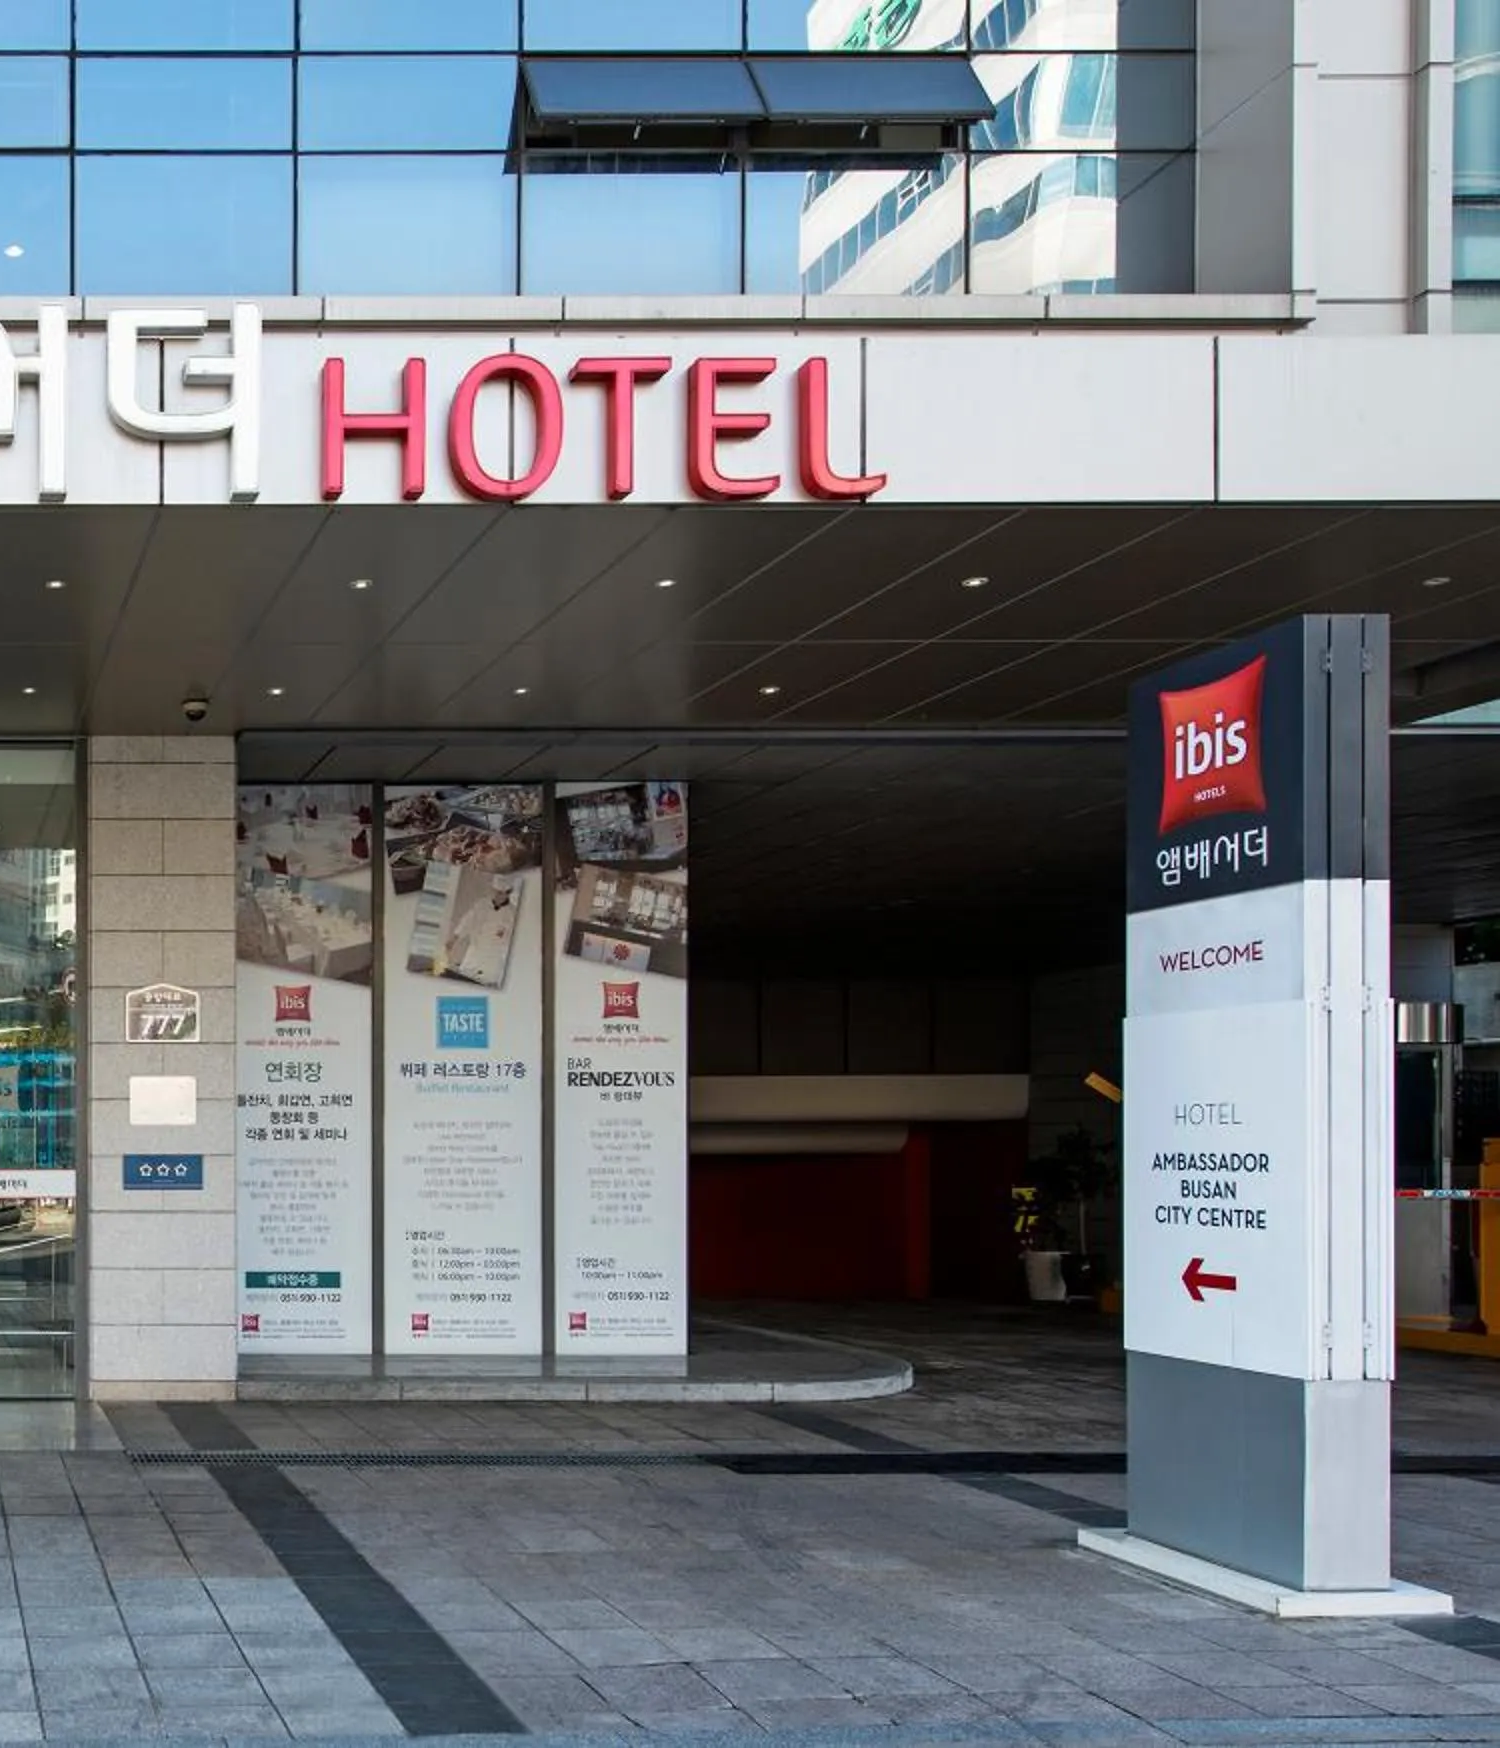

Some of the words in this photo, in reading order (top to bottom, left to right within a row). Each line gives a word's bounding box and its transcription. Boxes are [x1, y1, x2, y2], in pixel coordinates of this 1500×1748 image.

[321, 352, 887, 502] HOTEL
[1175, 711, 1247, 780] ibis
[1156, 826, 1268, 886] 앰배서더
[1160, 941, 1263, 973] WELCOME
[280, 995, 306, 1009] ibis
[608, 992, 635, 1007] ibis
[141, 1015, 186, 1035] 777
[443, 1013, 484, 1032] TASTE
[265, 1062, 322, 1083] 연회장
[433, 1062, 488, 1078] 레스토랑
[496, 1061, 527, 1079] 17층
[567, 1057, 592, 1070] BAR
[567, 1071, 676, 1087] RENDEZVOUS
[1174, 1103, 1243, 1126] HOTEL
[313, 1128, 348, 1141] 세미나
[1151, 1152, 1270, 1173] AMBASSADOR
[1181, 1179, 1237, 1201] BUSAN
[1155, 1205, 1192, 1225] CITY
[1197, 1207, 1267, 1230] CENTRE
